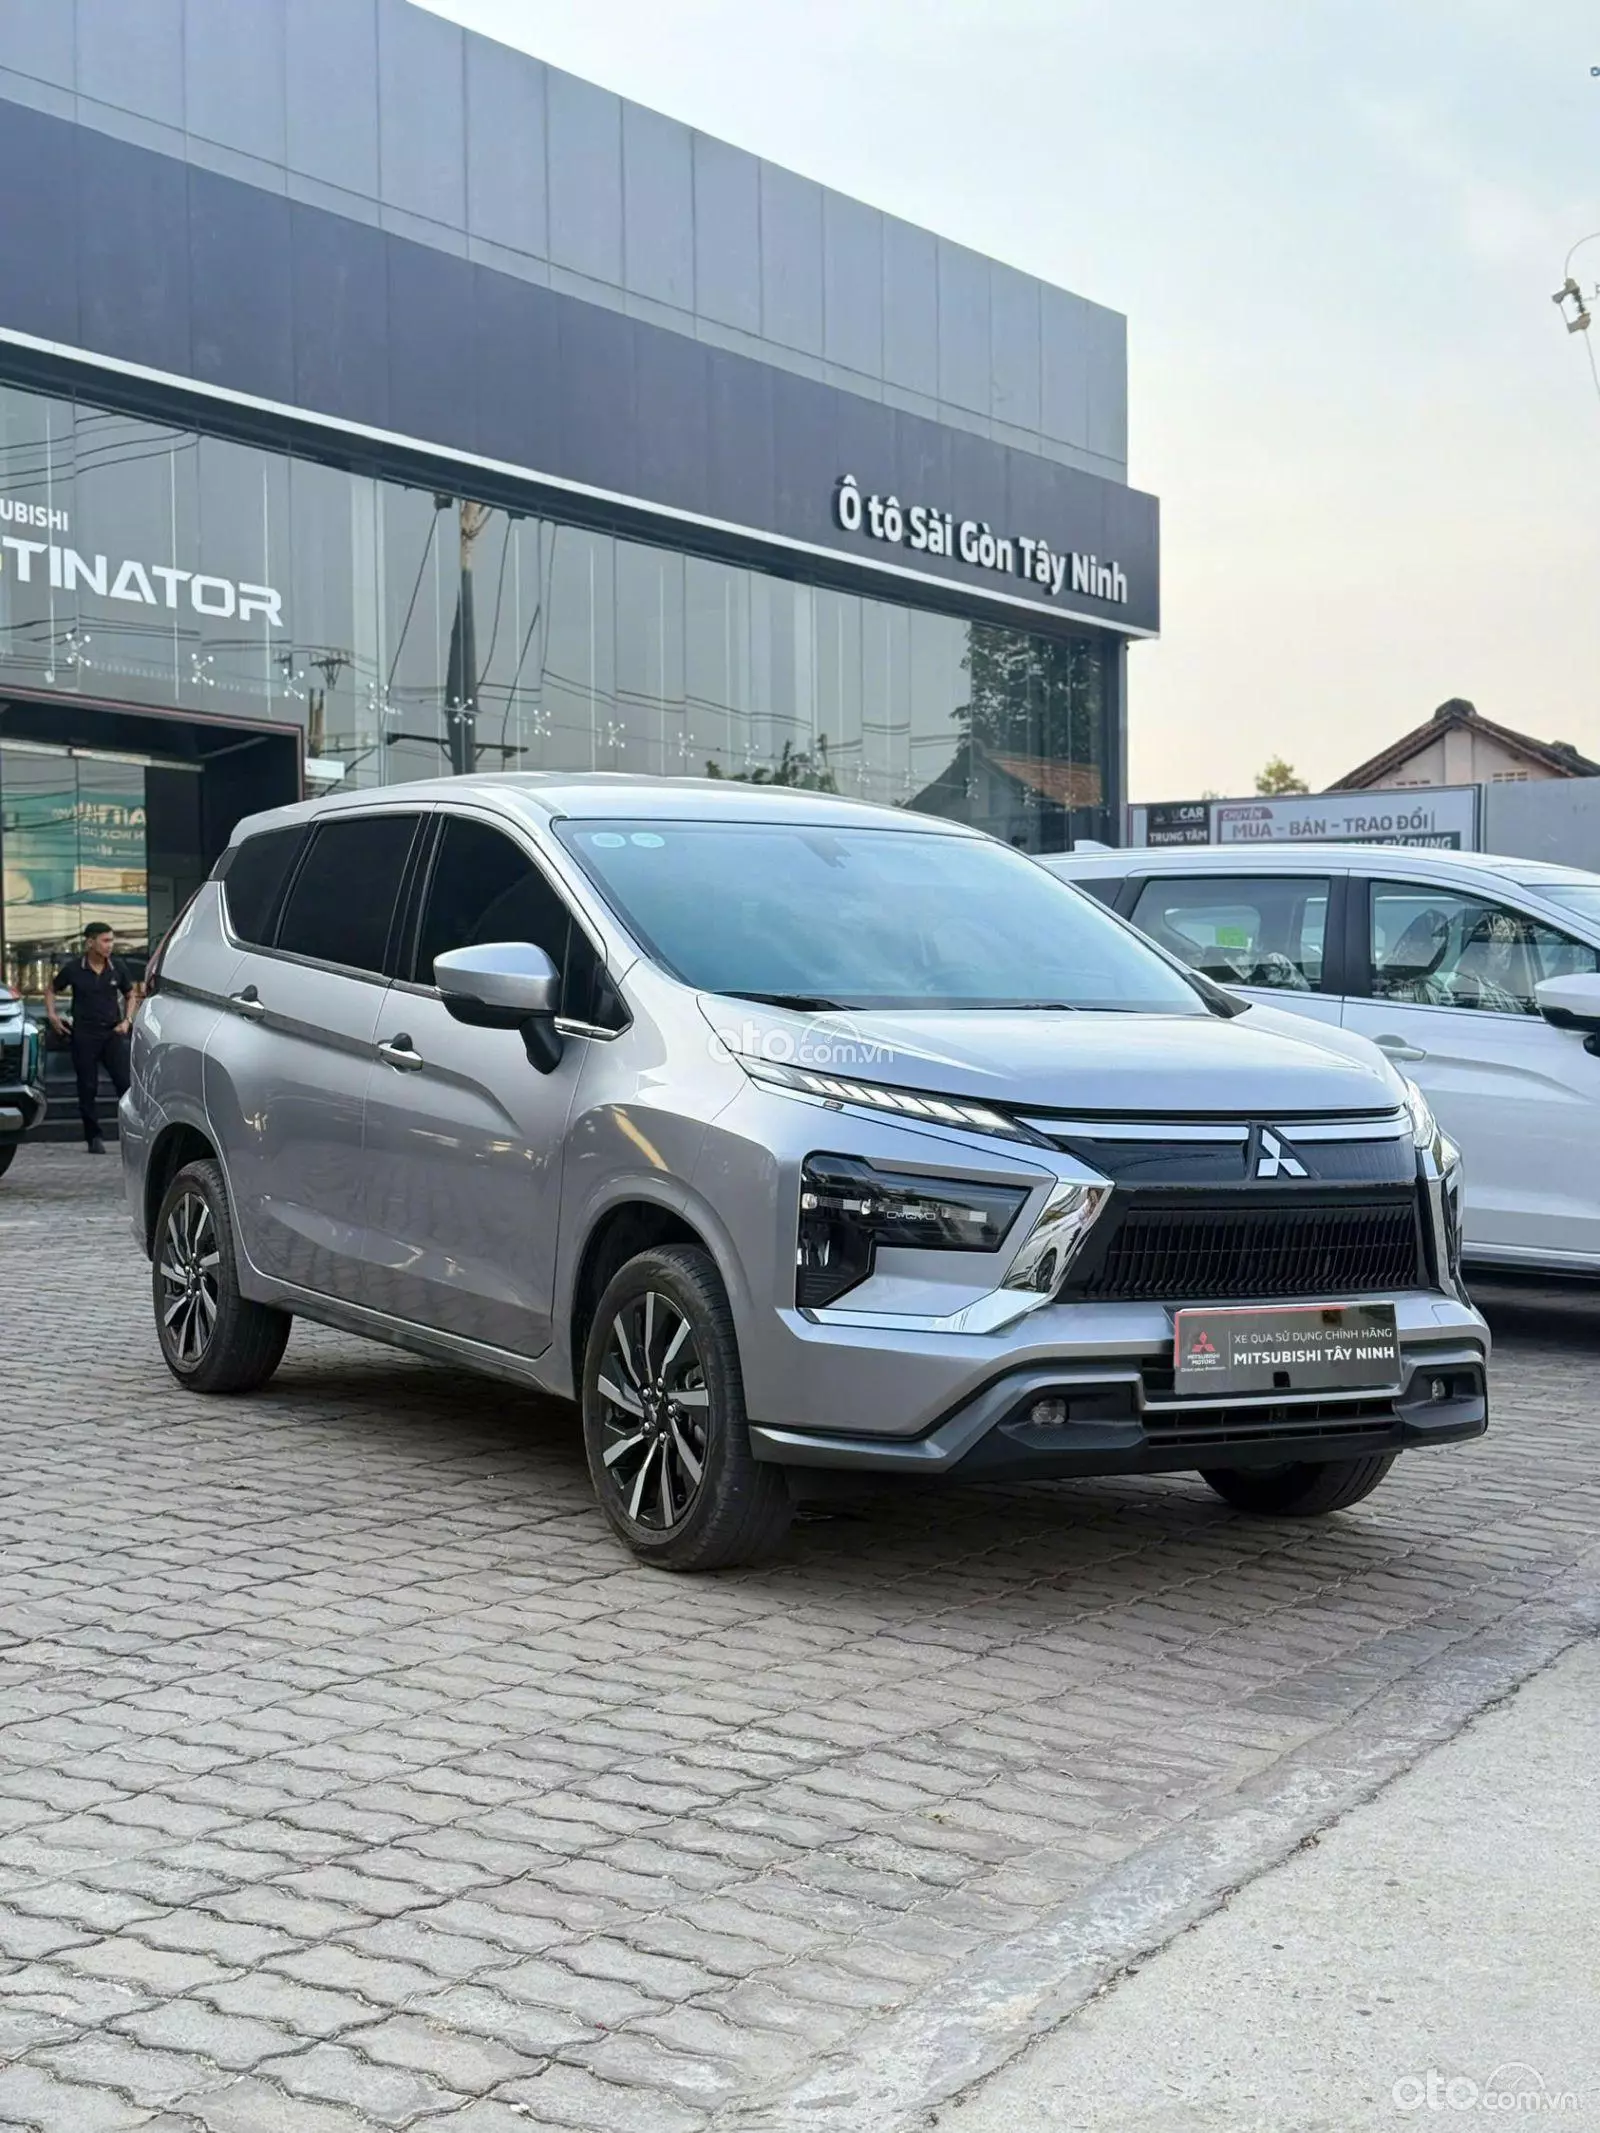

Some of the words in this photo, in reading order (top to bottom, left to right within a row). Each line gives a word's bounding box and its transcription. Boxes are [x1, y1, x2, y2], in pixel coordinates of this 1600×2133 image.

[838, 474, 862, 531] Ô
[869, 495, 903, 542] tô
[909, 506, 953, 556] Sài
[959, 521, 1013, 573] Gòn
[1018, 536, 1066, 595] Tây
[1071, 552, 1128, 604] Ninh
[0, 535, 284, 628] TINATOR
[1149, 830, 1184, 843] TRUNG
[1186, 827, 1208, 841] TÂM
[1232, 822, 1274, 839] MUA
[1289, 816, 1327, 836] BÁN
[1343, 815, 1393, 833] TRAO
[1234, 1334, 1247, 1344] XE
[1251, 1333, 1273, 1344] QUA
[1293, 1331, 1323, 1343] DỤNG
[1233, 1349, 1321, 1366] MITSUBISHI
[1324, 1345, 1353, 1361] TÂY
[1356, 1346, 1395, 1360] NINH
